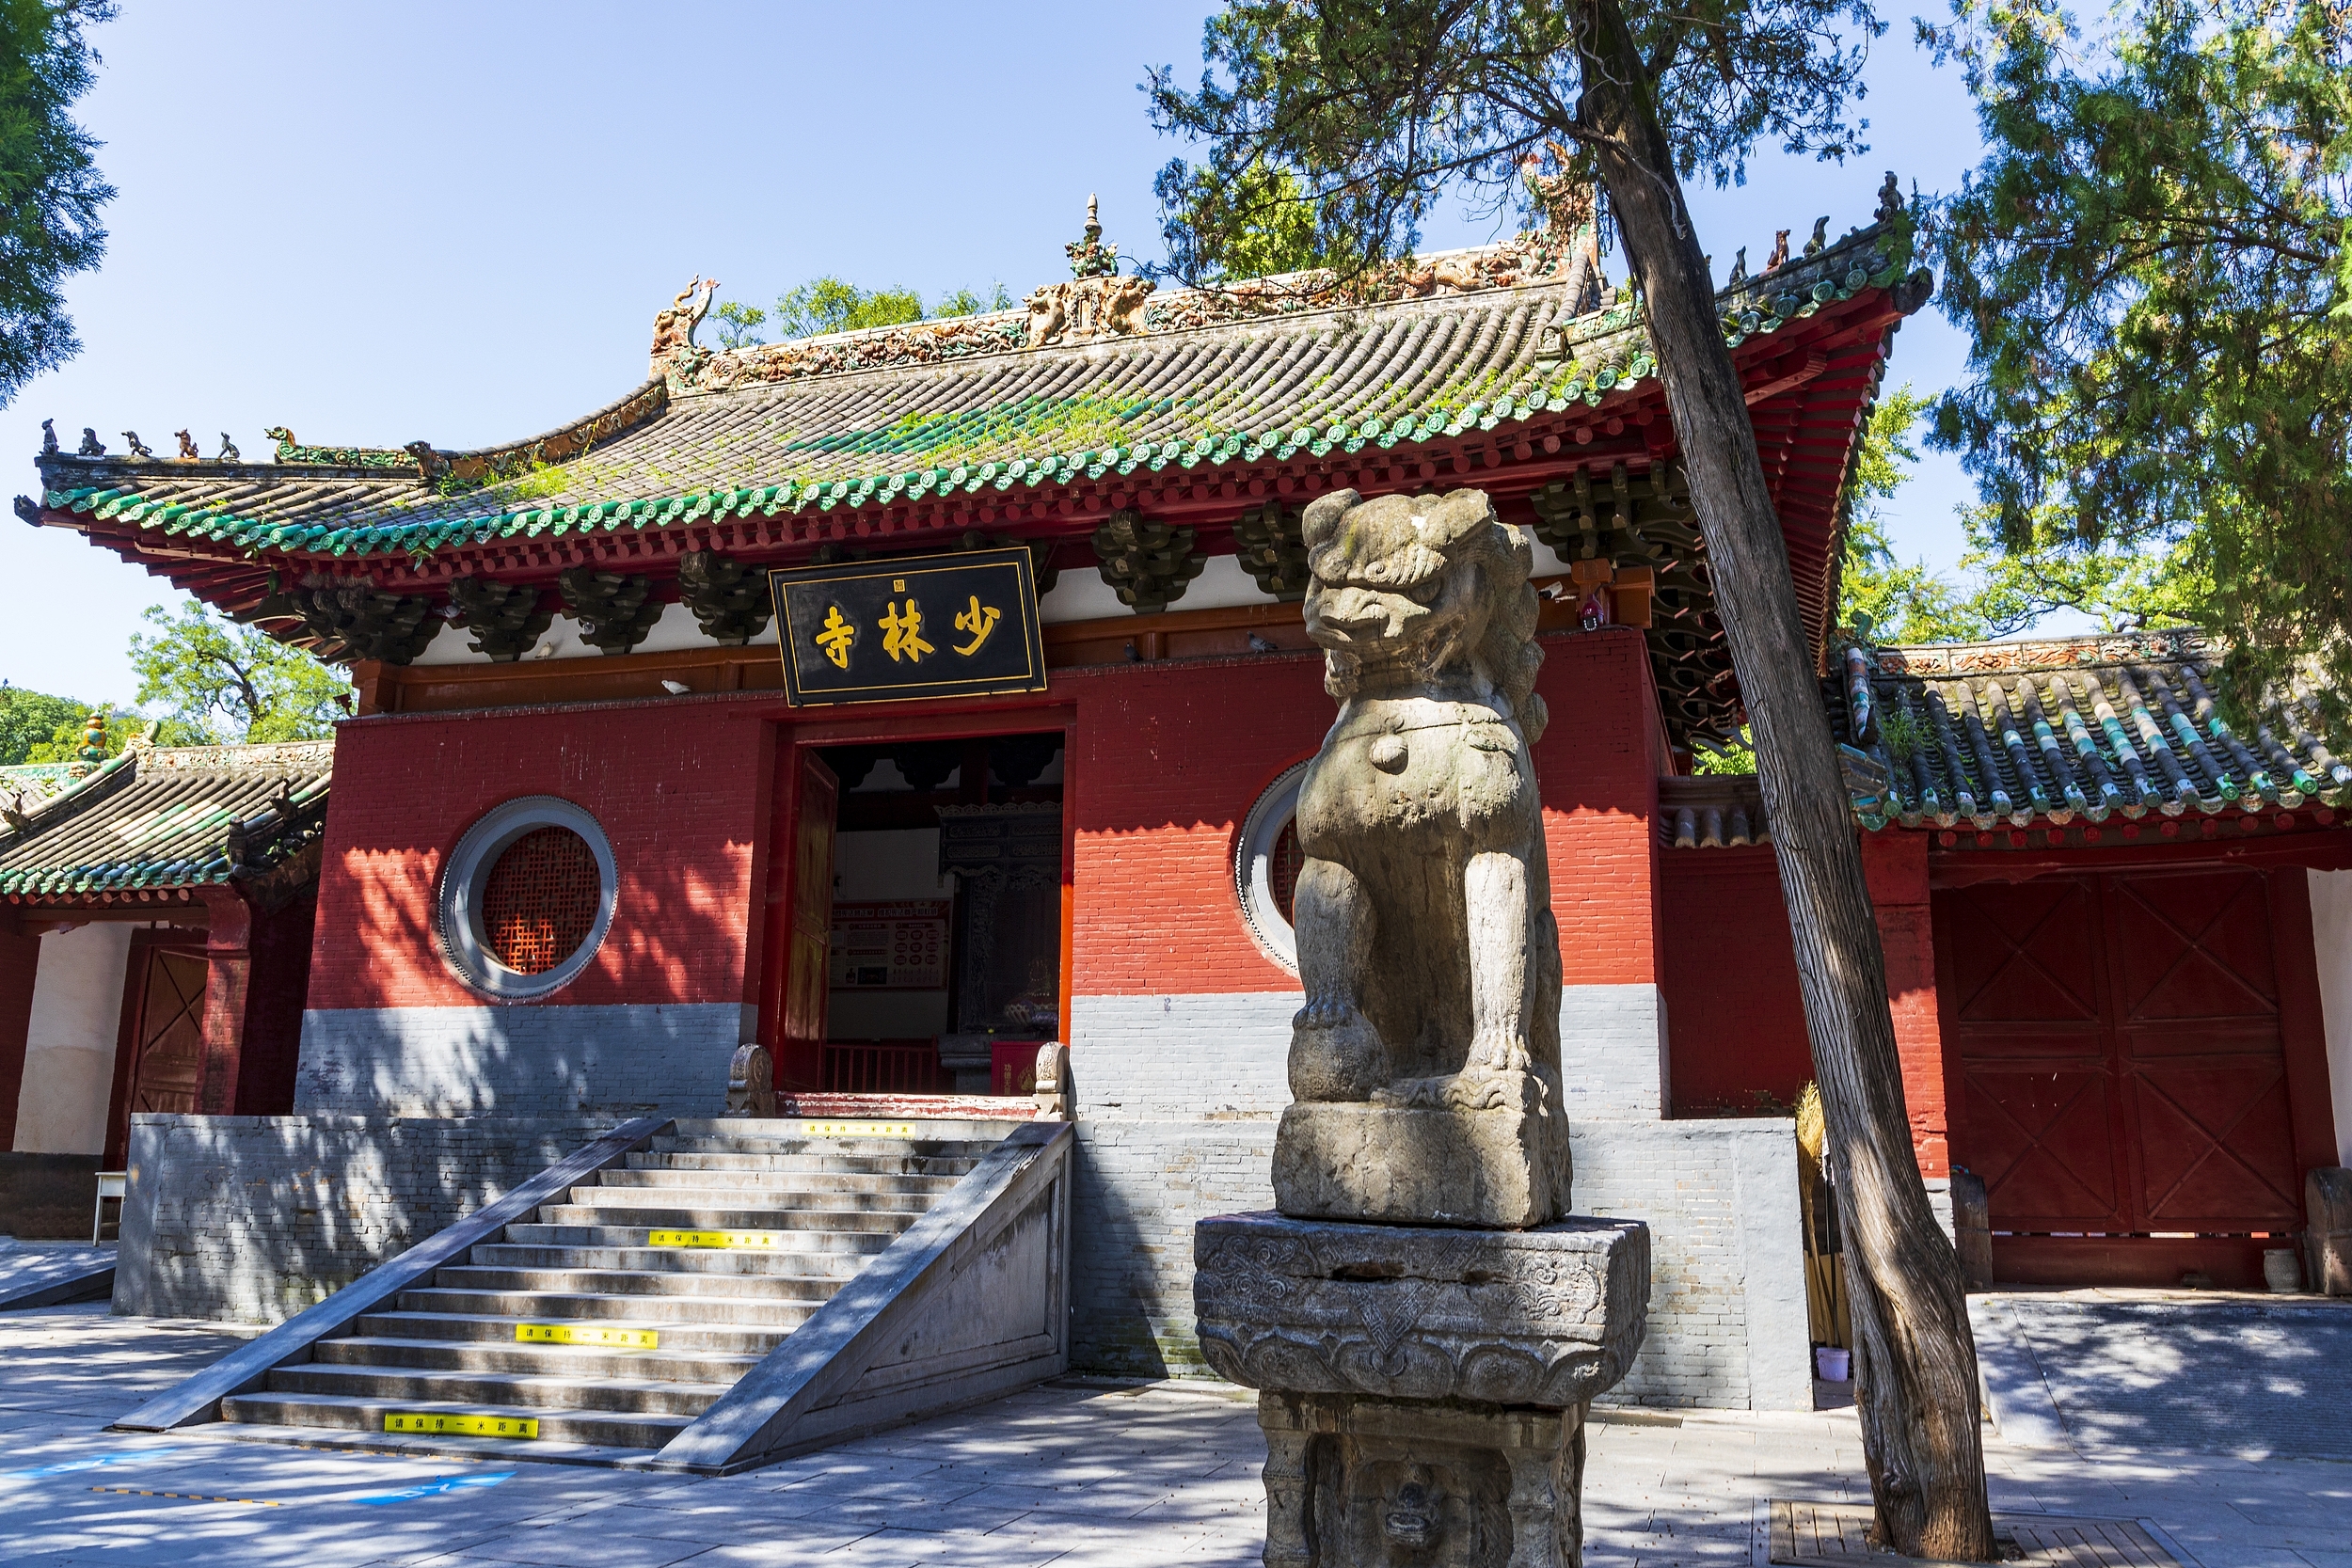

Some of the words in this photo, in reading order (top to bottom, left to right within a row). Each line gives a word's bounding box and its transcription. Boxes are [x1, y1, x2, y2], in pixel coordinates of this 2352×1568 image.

[815, 595, 1001, 669] 少林寺
[658, 1234, 770, 1244] 请保持一米距离
[526, 1328, 648, 1344] 请保持一米距离
[395, 1418, 528, 1433] 请保持一米距离
